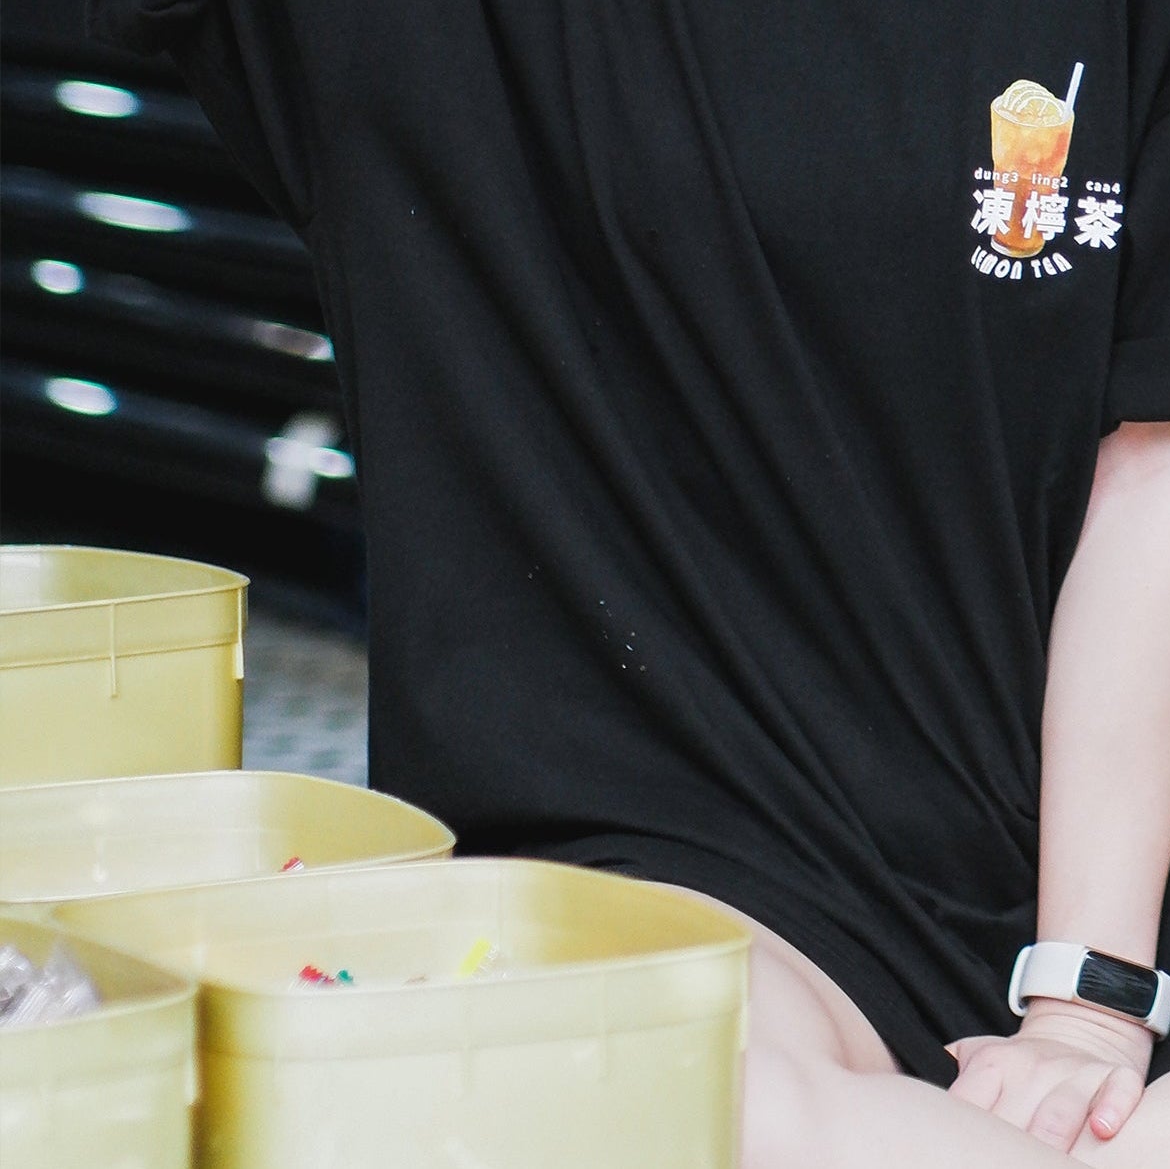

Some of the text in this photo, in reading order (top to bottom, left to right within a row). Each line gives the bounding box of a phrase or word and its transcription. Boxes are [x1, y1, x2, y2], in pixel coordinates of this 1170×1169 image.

[974, 167, 1121, 195] dung3 ling2 caa4
[970, 187, 1124, 250] 凍檸茶
